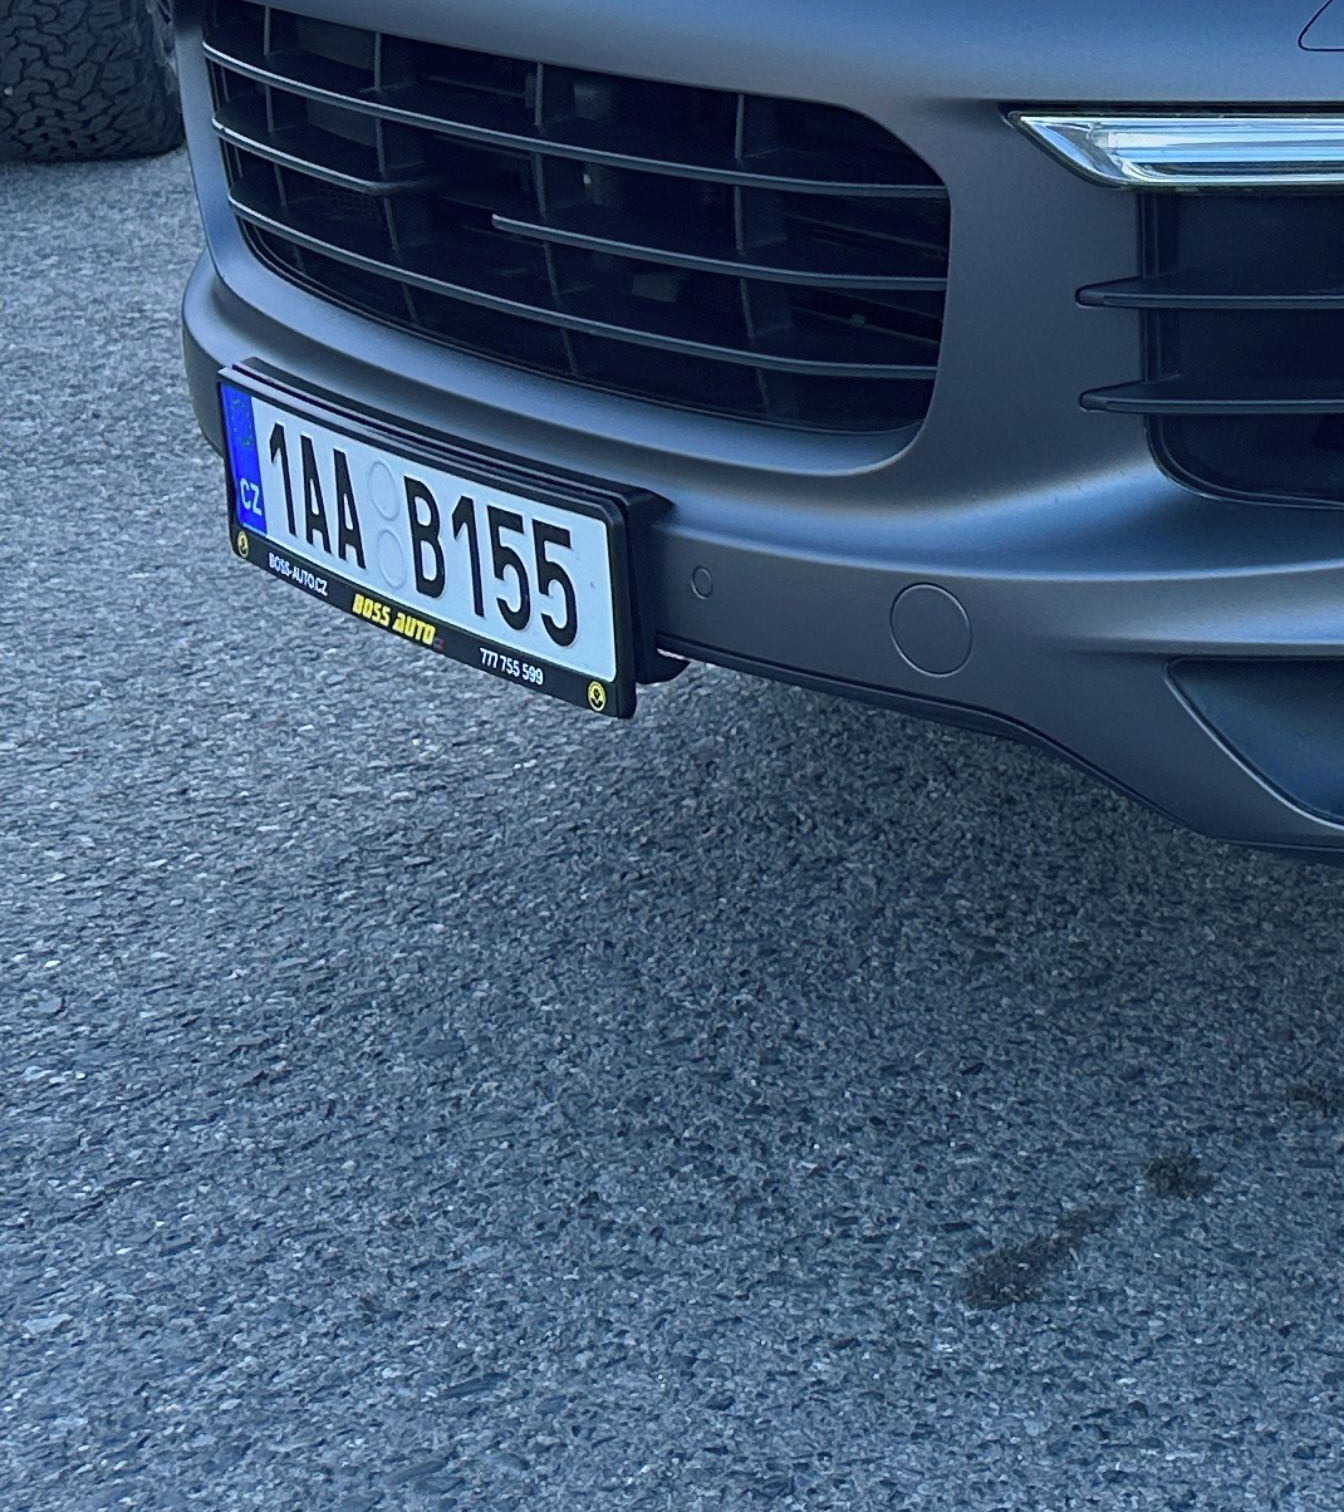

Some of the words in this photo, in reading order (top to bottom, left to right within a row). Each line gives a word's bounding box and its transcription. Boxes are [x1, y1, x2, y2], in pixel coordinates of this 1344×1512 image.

[239, 478, 262, 516] CZ
[269, 422, 367, 570] 1AA
[404, 475, 578, 646] B155
[352, 593, 391, 626] BOSS
[480, 647, 498, 669] 777
[499, 655, 520, 678] 755
[522, 662, 544, 686] 599
